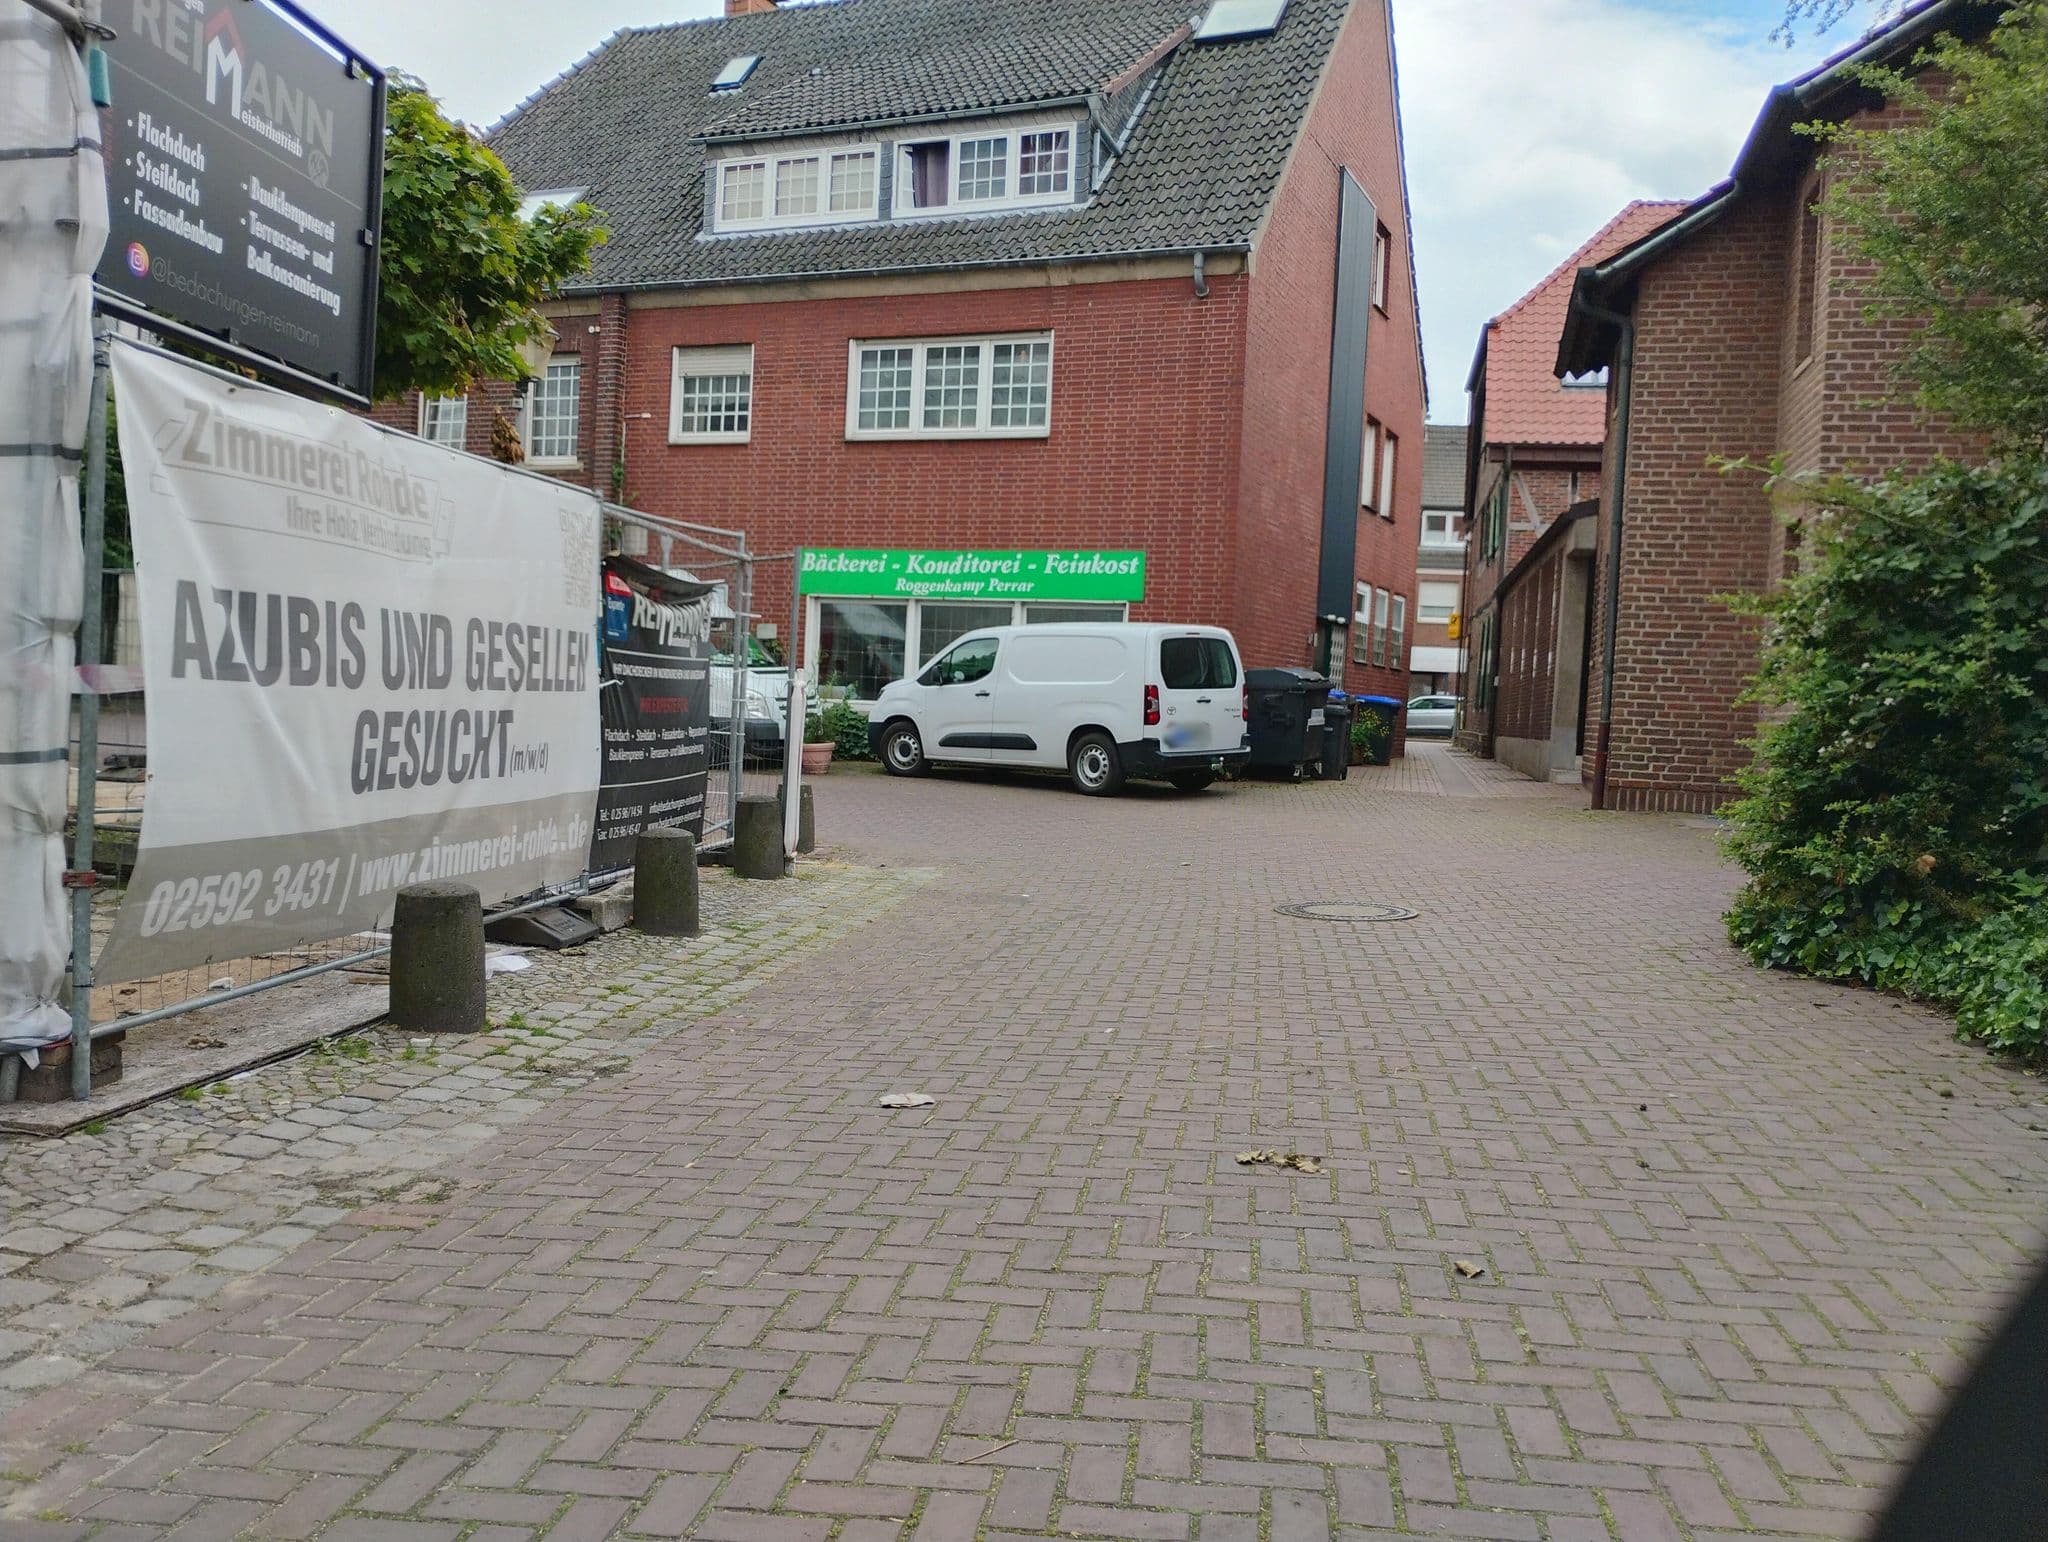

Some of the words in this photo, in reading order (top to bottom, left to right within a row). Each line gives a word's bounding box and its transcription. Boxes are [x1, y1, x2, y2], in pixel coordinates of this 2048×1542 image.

[132, 0, 334, 158] REIMANN
[137, 112, 205, 172] Flachdach
[136, 151, 200, 206] Steildach
[134, 188, 223, 254] Fassadenbau
[247, 245, 341, 316] Balkonsanierung
[181, 398, 351, 496] Zimmerei
[357, 452, 430, 520] Rohde
[286, 496, 321, 533] Ihre
[326, 505, 359, 541] Holz
[801, 552, 887, 573] Bäckerei
[906, 553, 1021, 575] Konditorei
[1044, 553, 1139, 576] Feinkost
[895, 578, 984, 596] Roggenkamp
[987, 579, 1035, 593] Perrar
[171, 579, 367, 691] AZUBIS
[381, 607, 454, 692] UND
[466, 617, 590, 693] GESELLEN
[351, 708, 513, 794] GESUCHT
[510, 741, 549, 779] (m/w/d)
[141, 867, 264, 938] 02592
[264, 856, 340, 917] 3431
